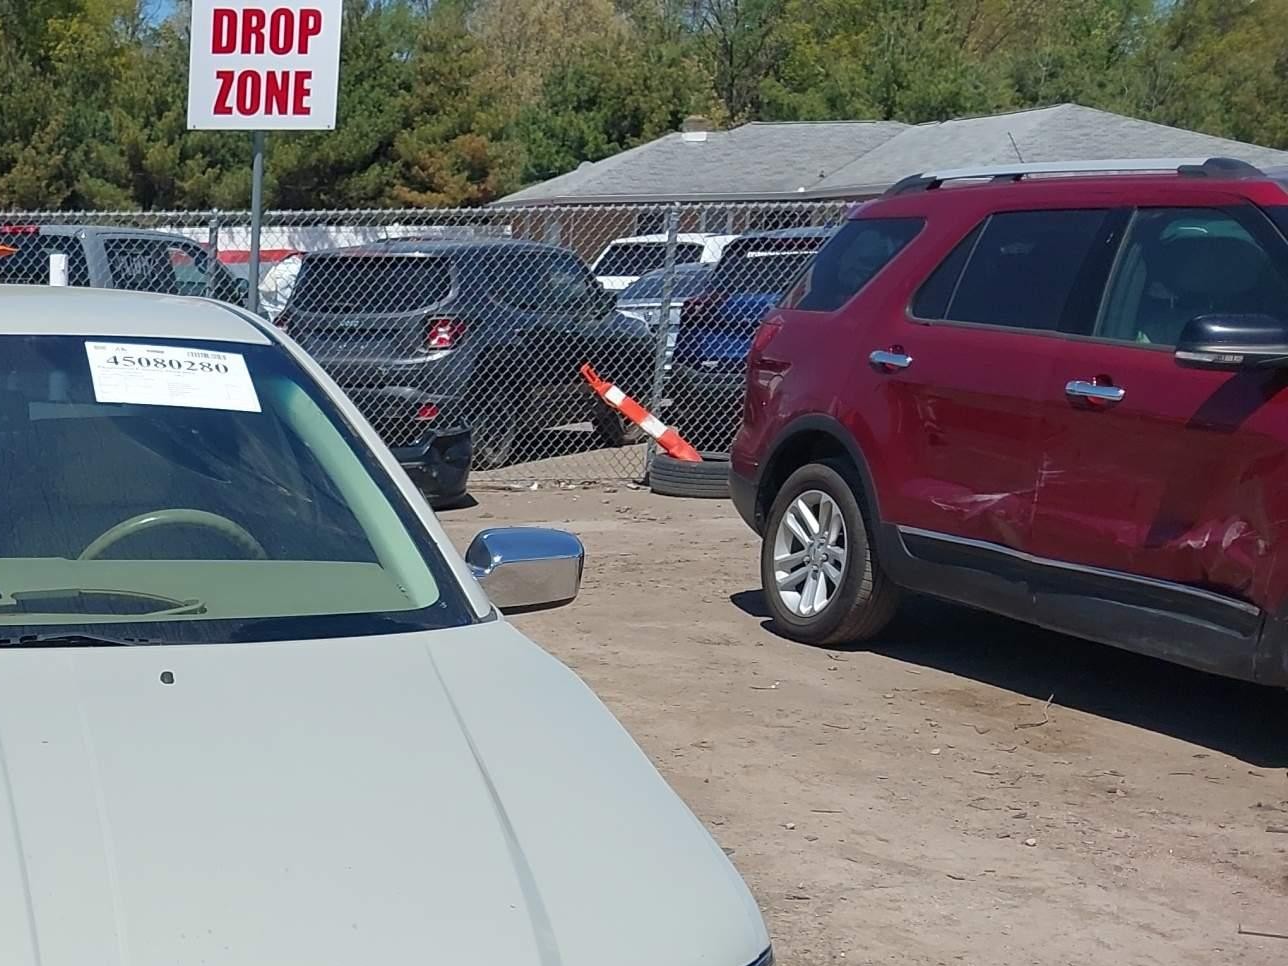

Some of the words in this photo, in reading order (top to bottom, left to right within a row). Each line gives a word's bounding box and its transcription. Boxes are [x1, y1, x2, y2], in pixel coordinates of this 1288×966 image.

[211, 8, 322, 54] DROP
[211, 70, 312, 116] ZONE
[106, 355, 229, 374] 45080280
